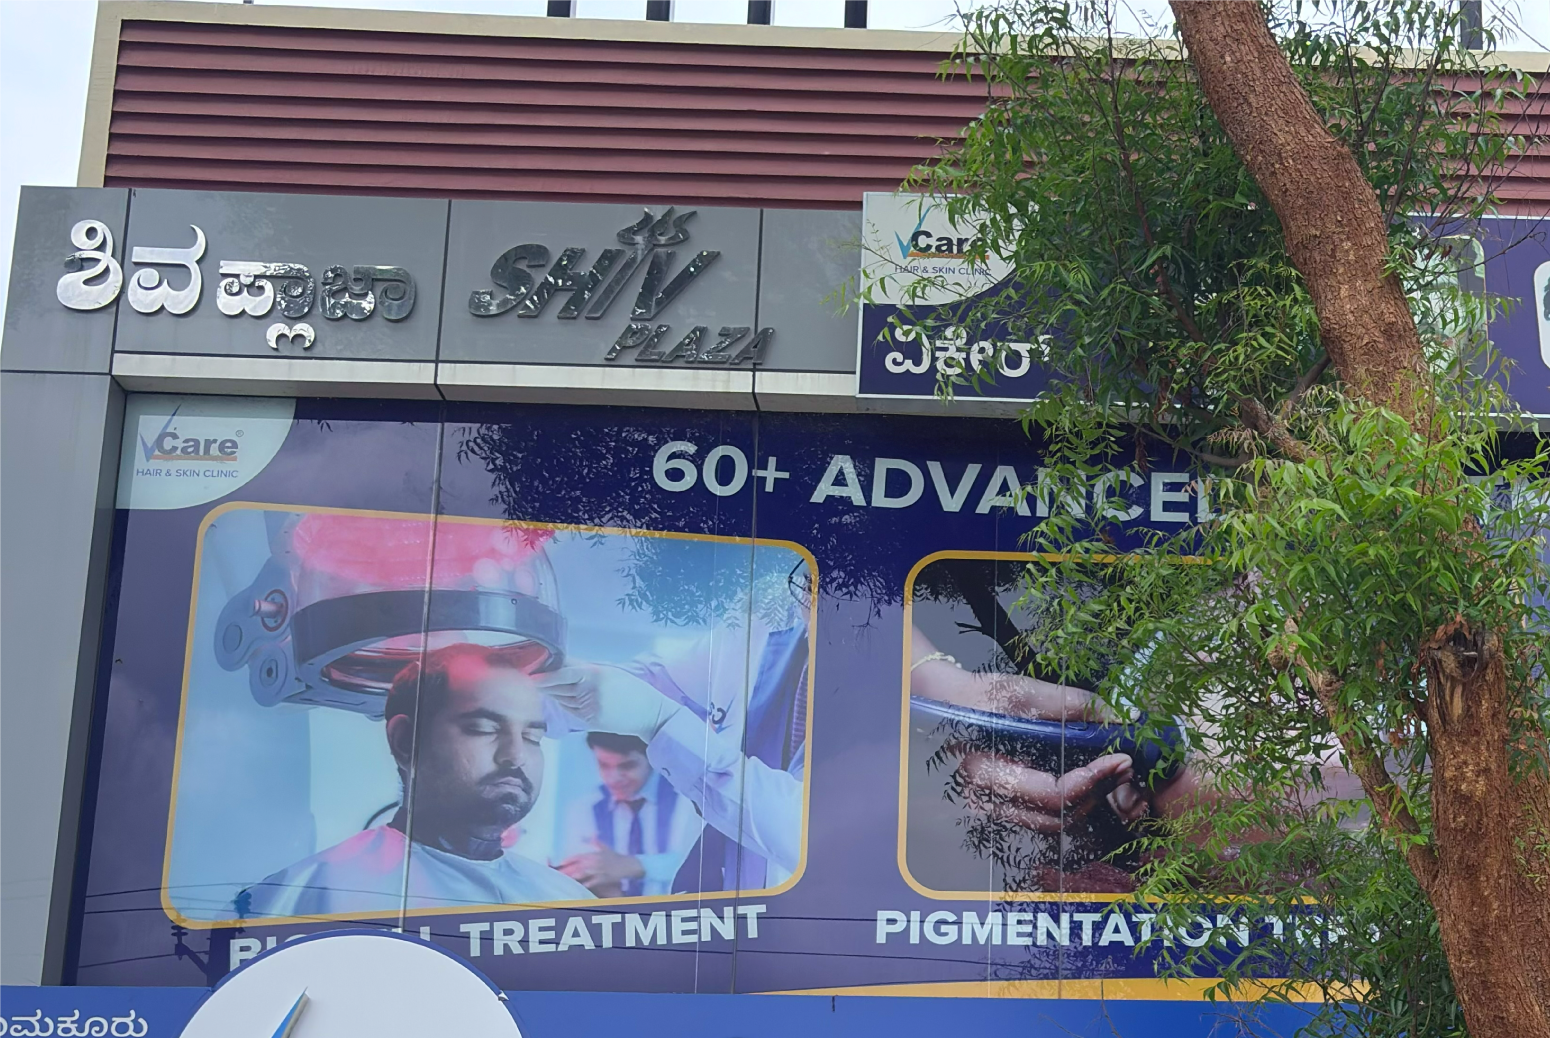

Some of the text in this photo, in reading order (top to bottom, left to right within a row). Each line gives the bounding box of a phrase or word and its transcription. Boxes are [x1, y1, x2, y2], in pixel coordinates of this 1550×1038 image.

[57, 219, 417, 350] ಶಿವ ಪ್ಲಾಜಾ
[469, 225, 721, 321] SHIV
[895, 265, 992, 277] HAIR SKIN CLINIC
[604, 324, 776, 365] PLAZA
[136, 468, 239, 479] HAIR SKIN CLINIC
[652, 440, 790, 497] 60+
[460, 904, 768, 958] TREATMENT
